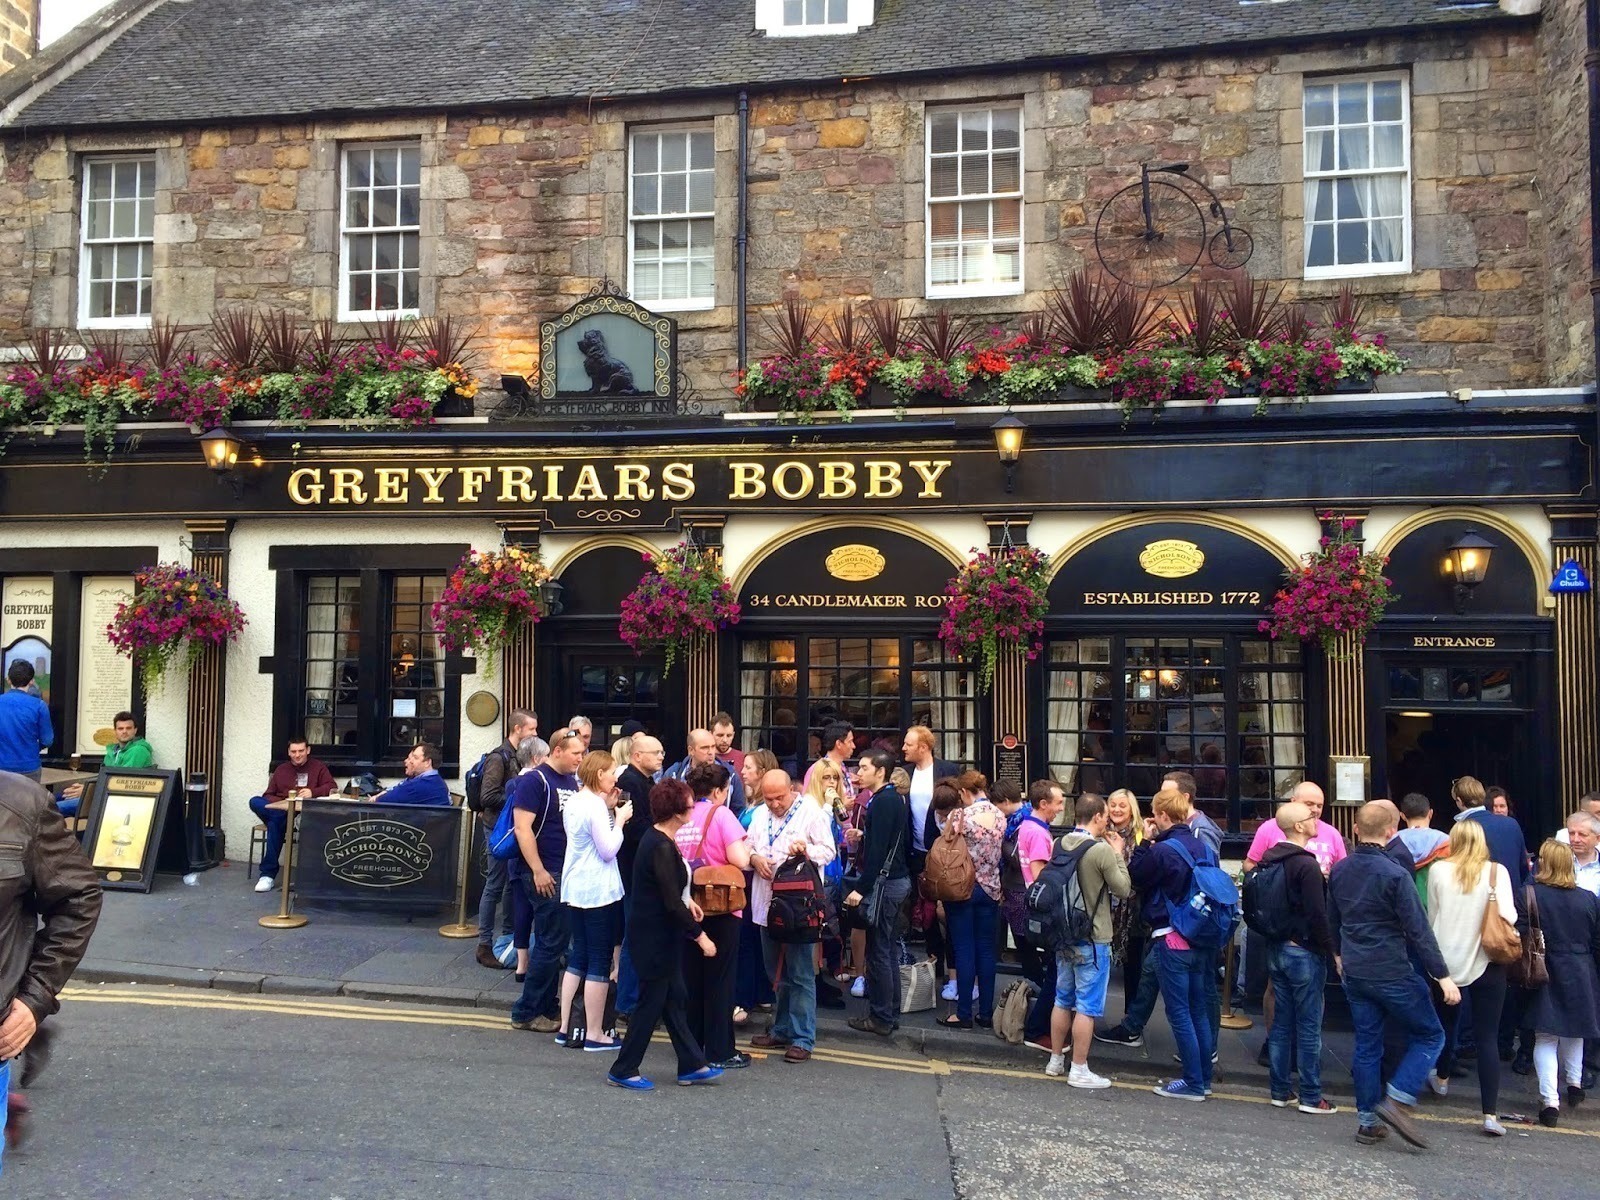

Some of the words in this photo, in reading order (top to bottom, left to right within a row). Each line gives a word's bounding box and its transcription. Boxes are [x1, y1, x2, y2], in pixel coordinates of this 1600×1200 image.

[612, 401, 646, 413] BOBBY
[651, 400, 671, 412] INN
[287, 462, 696, 506] GREYFRIARS
[728, 460, 952, 501] BOBBY
[750, 594, 770, 607] 34
[775, 594, 907, 608] CANDLEMAKER
[1083, 592, 1214, 605] ESTABLISHED
[1220, 591, 1261, 605] 1772
[16, 619, 46, 630] BOBBY
[1413, 636, 1496, 647] ENTRANCE
[381, 824, 401, 835] 1873
[335, 842, 422, 864] NICHOLSON'S
[353, 864, 402, 873] FREEHOUSE
